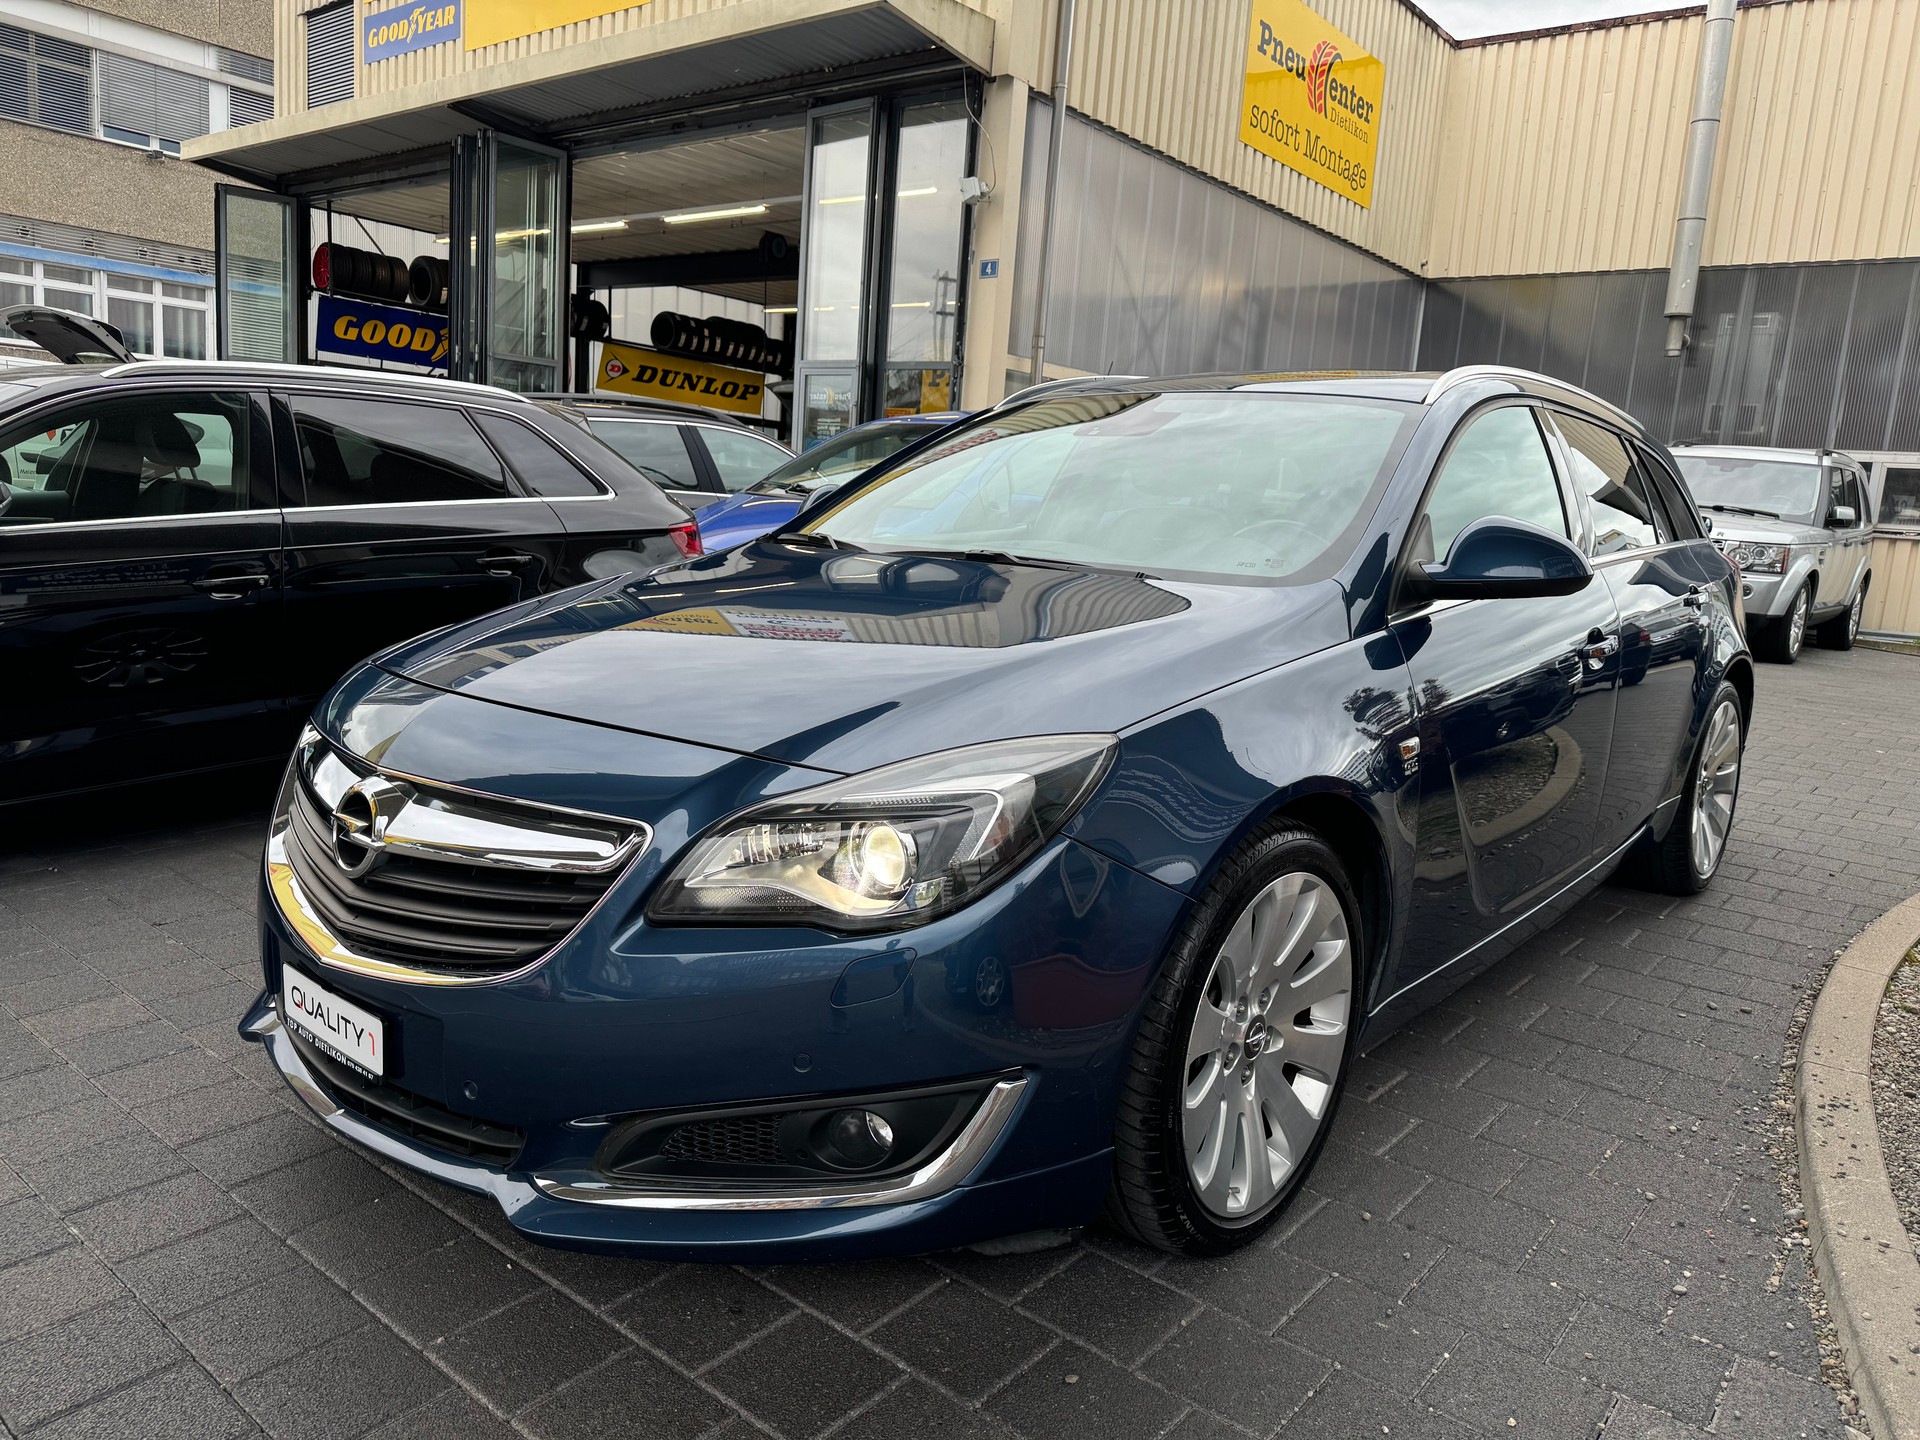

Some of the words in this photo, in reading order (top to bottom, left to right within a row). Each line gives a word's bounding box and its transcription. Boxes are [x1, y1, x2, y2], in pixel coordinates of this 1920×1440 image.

[368, 5, 455, 48] GOODYEAR
[1257, 20, 1306, 82] Pneu
[1330, 107, 1369, 144] Dietlikon
[1250, 104, 1300, 152] sofort
[1303, 129, 1367, 191] Montage
[985, 262, 992, 275] 4
[631, 364, 761, 401] DUNLOP
[286, 1017, 298, 1031] TOP
[298, 1025, 313, 1043] AUTO
[315, 1037, 347, 1065] DIETLIKON
